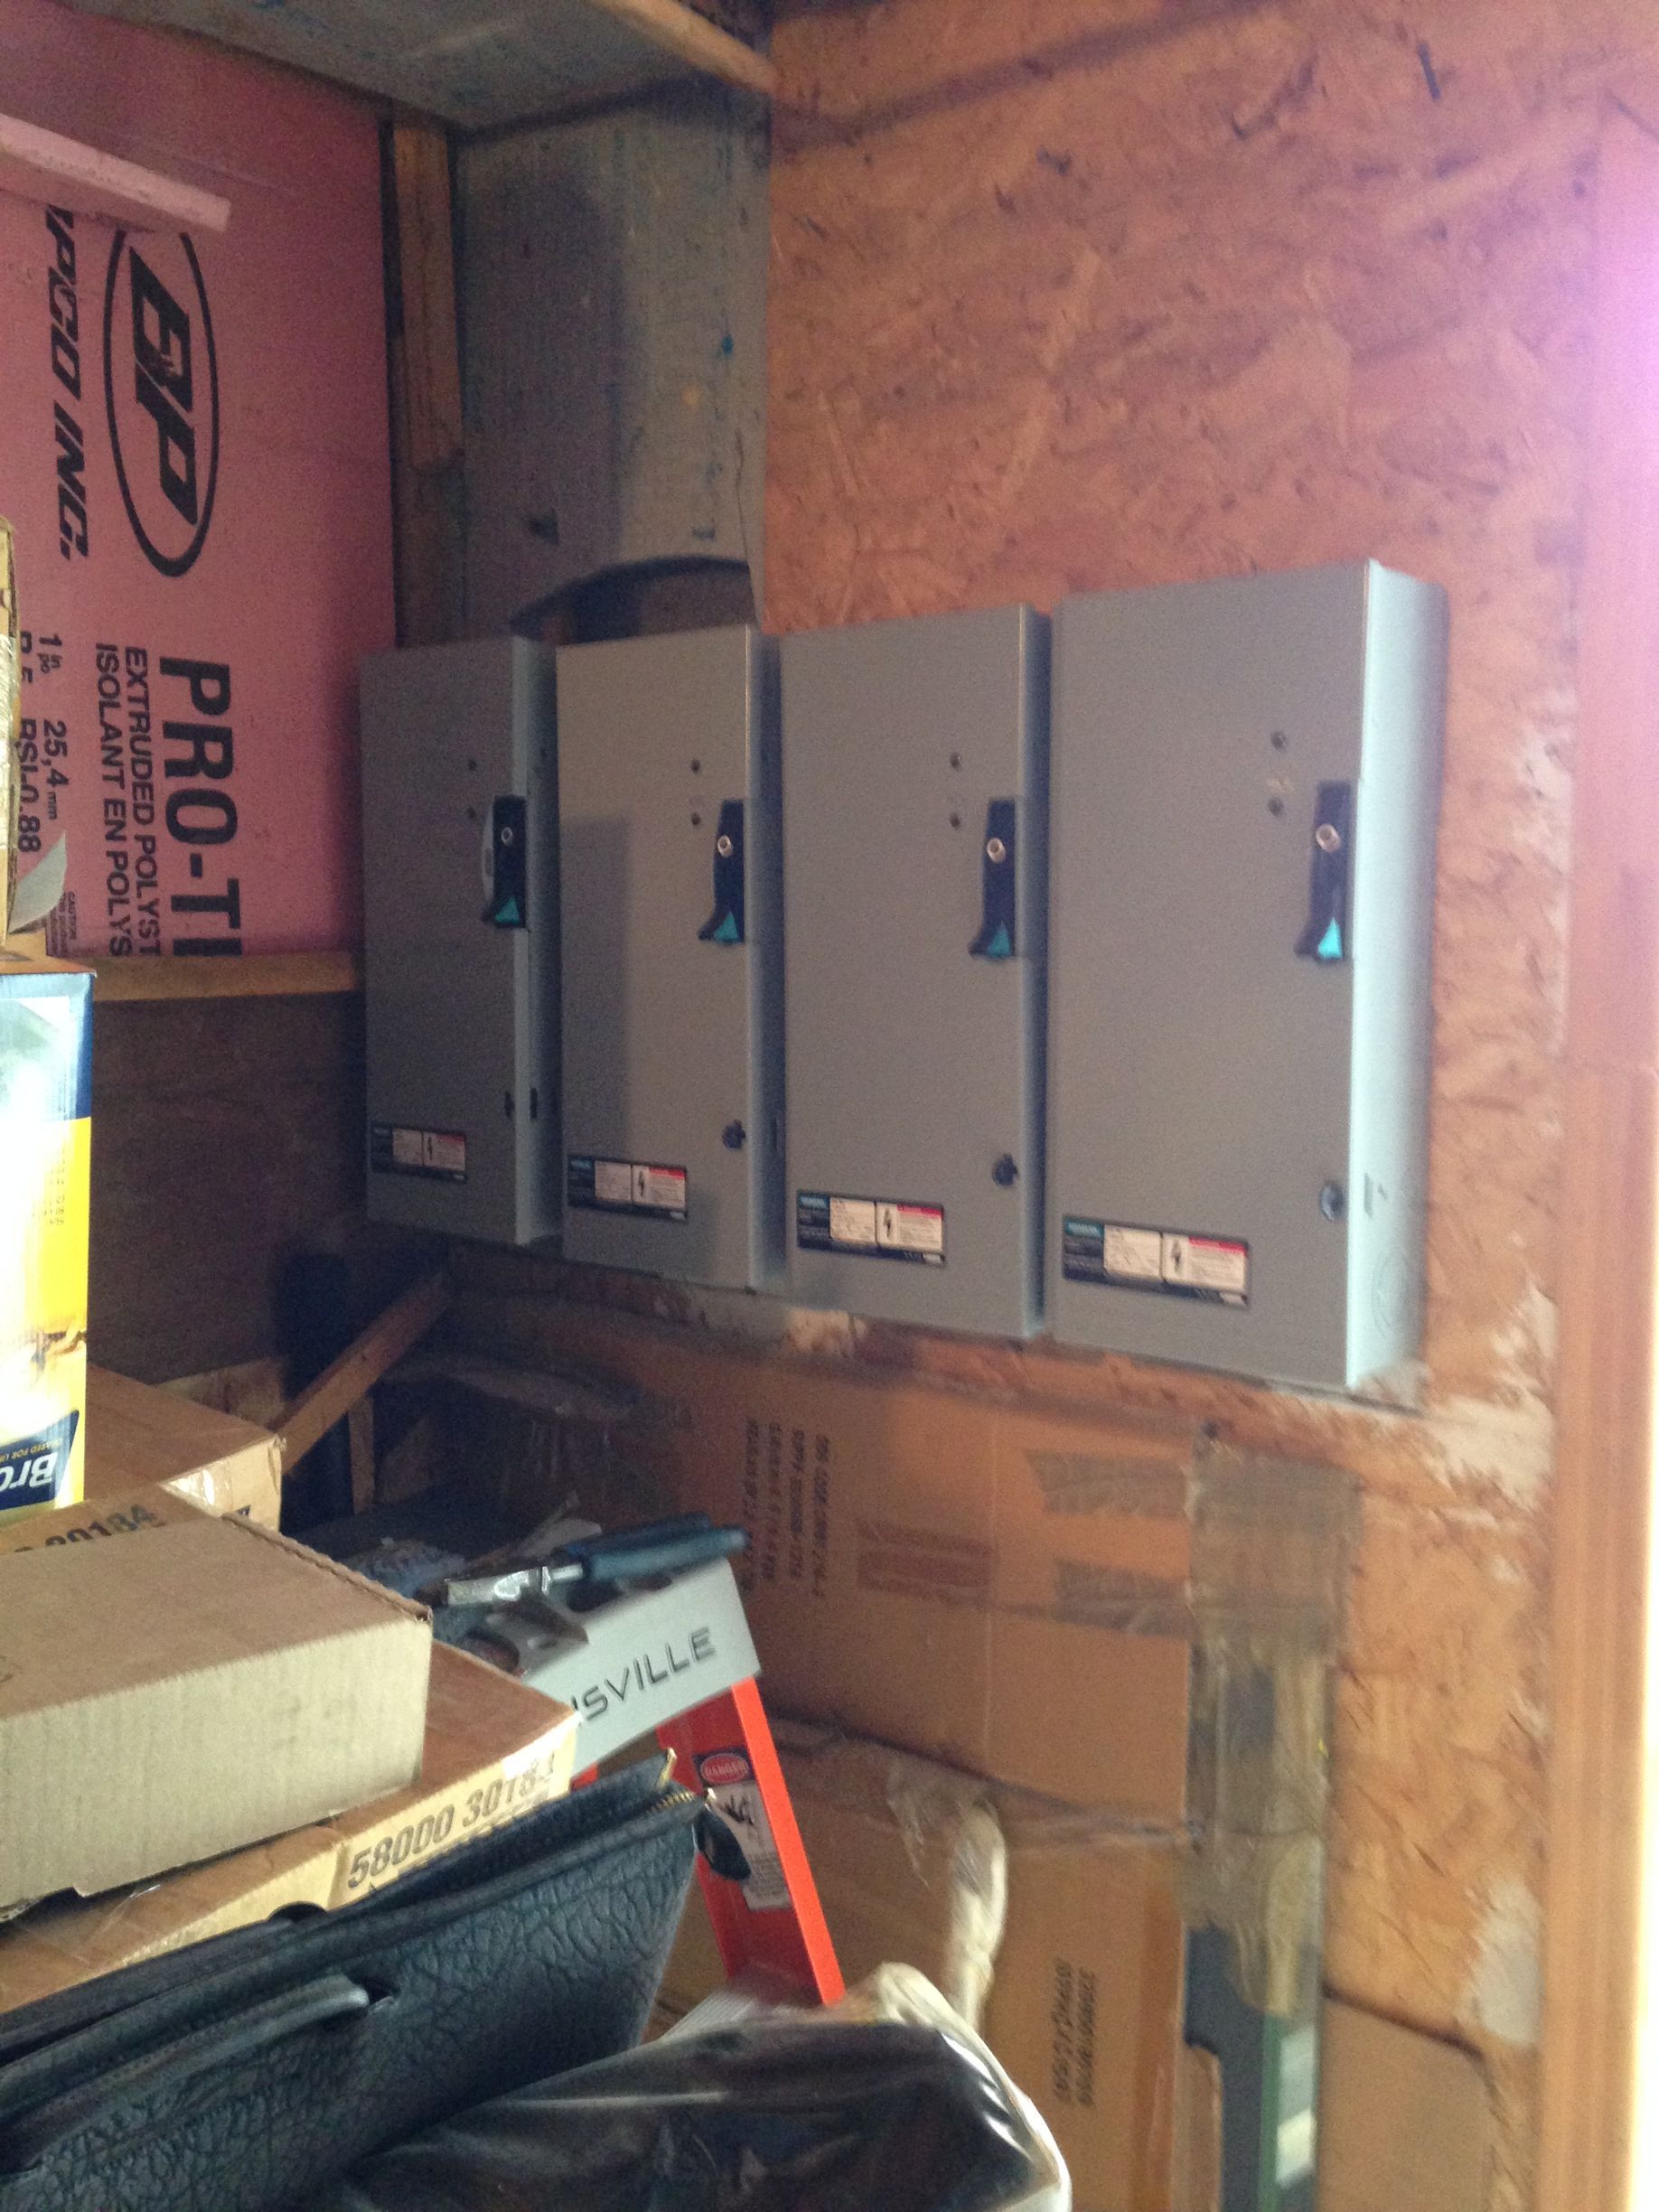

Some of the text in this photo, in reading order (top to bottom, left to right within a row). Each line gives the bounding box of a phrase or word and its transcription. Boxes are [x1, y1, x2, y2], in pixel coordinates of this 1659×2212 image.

[46, 204, 89, 560] PCO INC.
[129, 245, 198, 526] BP
[42, 718, 70, 786] 25,4
[96, 642, 132, 957] ISOLANT EN POLYS
[125, 645, 156, 826] EXTRUDED
[348, 1803, 455, 1889] 58000
